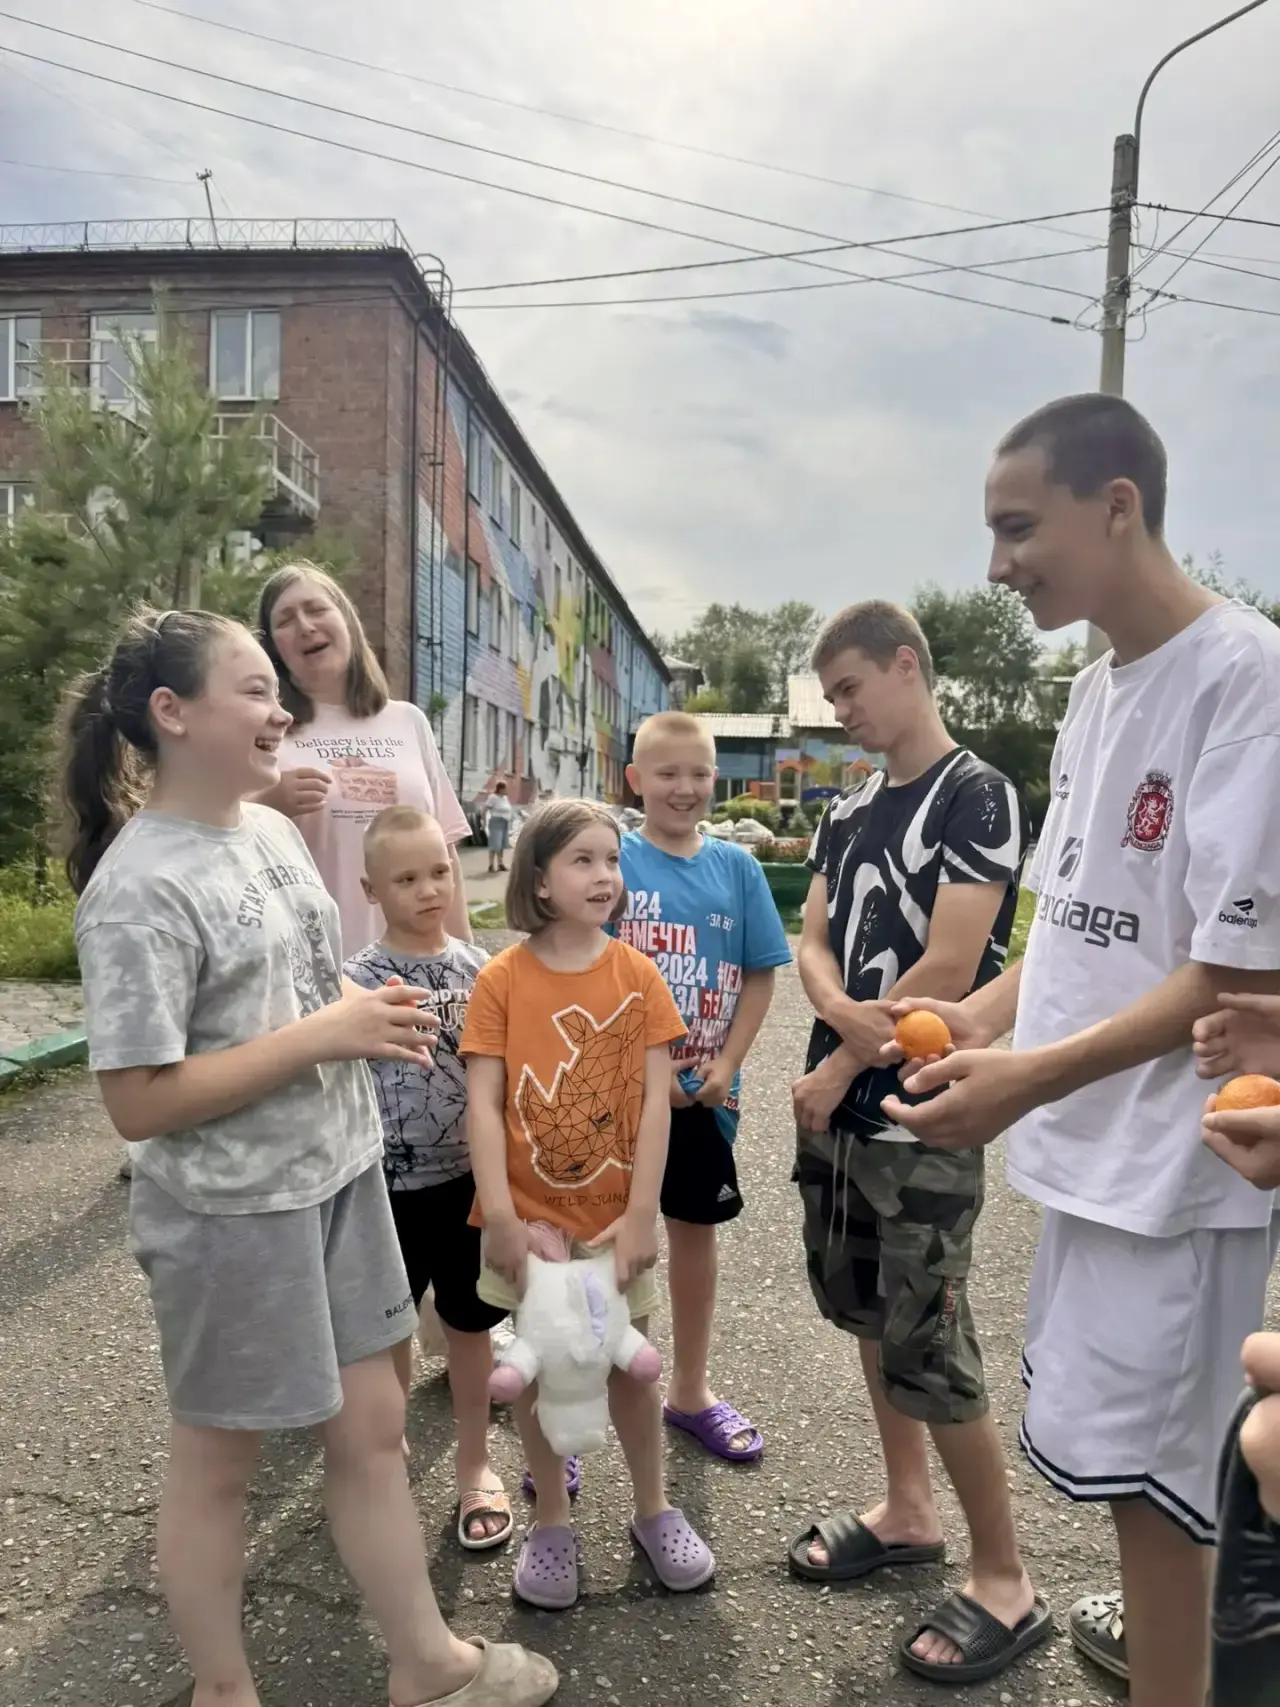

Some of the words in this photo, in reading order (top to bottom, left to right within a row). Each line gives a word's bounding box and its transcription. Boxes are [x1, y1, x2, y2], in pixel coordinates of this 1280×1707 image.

[295, 737, 352, 748] Delicacy
[355, 737, 367, 746] is
[369, 737, 383, 746] in
[385, 737, 404, 746] the
[316, 747, 395, 759] DETAILS
[237, 882, 266, 929] STAY
[621, 890, 661, 920] 024
[618, 920, 697, 955] #МЕЧТА
[545, 1194, 588, 1206] WILD
